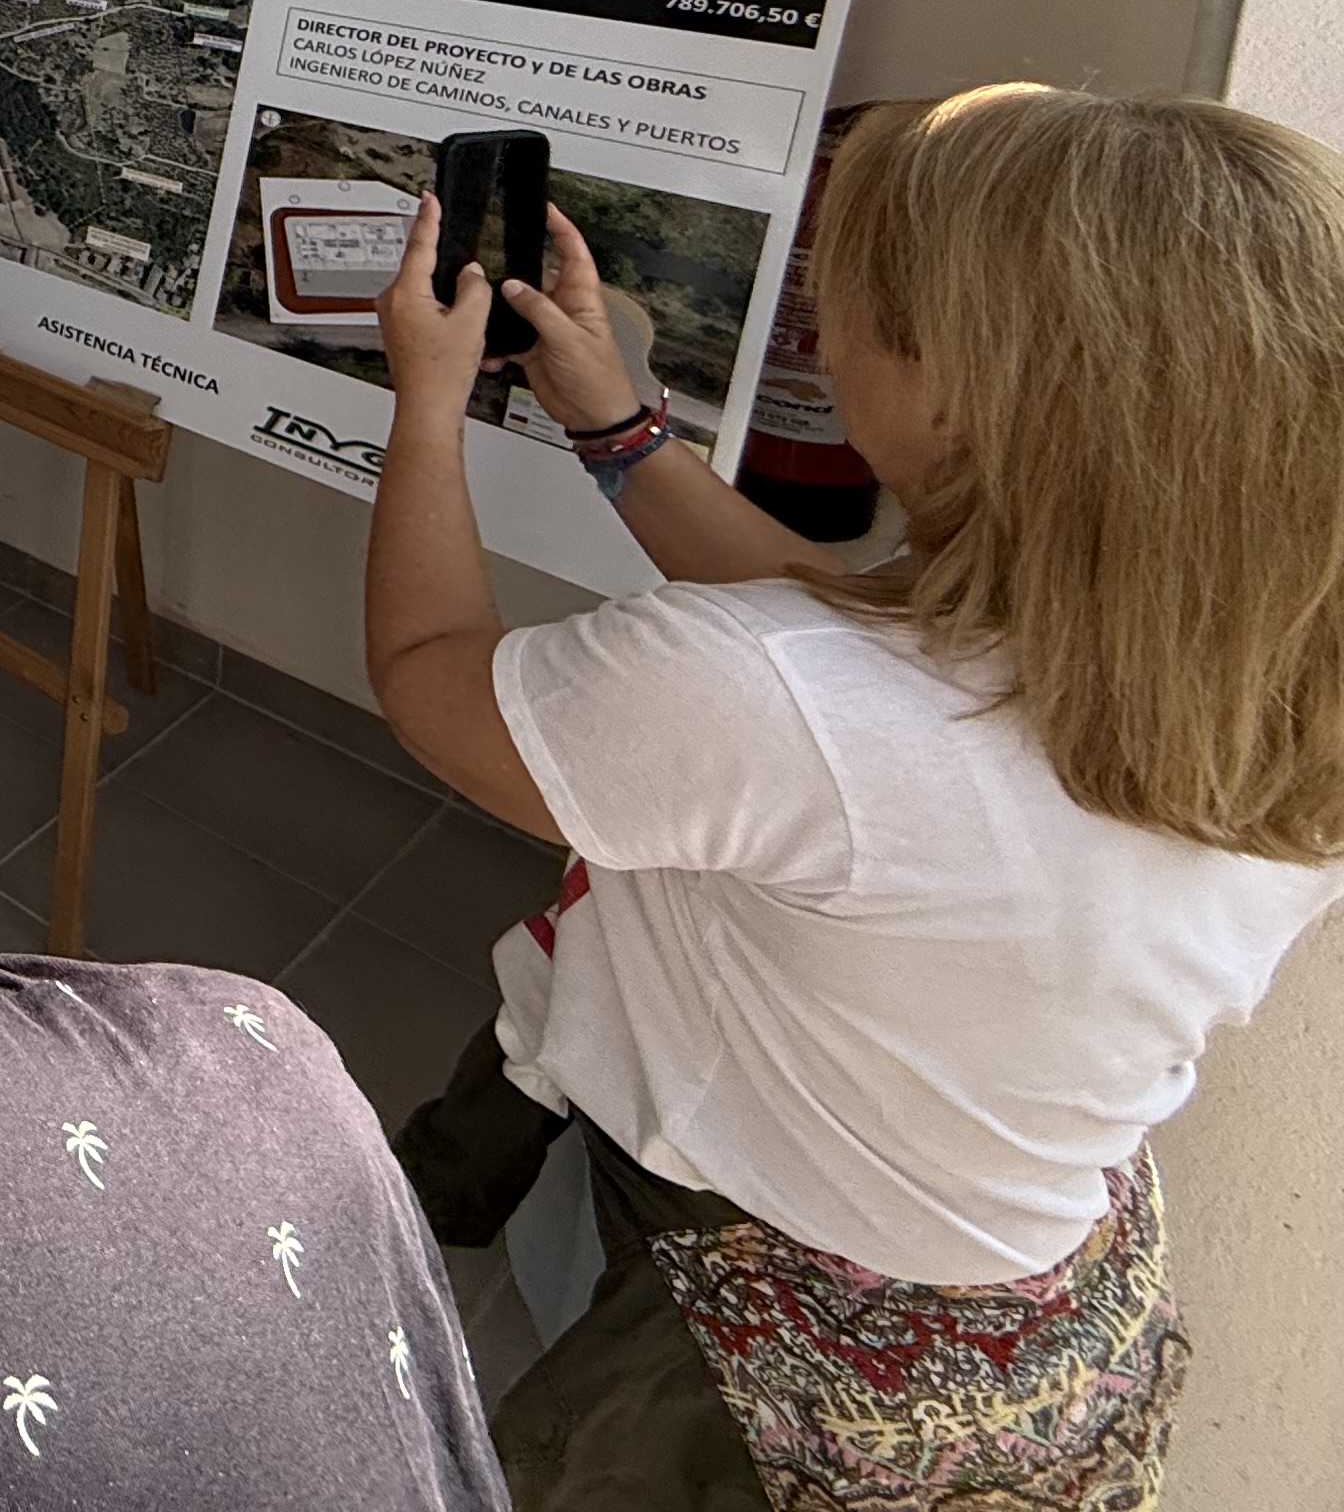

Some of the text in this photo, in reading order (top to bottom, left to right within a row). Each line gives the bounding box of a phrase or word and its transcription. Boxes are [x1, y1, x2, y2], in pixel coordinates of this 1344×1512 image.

[804, 12, 822, 29] €
[293, 37, 486, 85] CARLOS LÓPEZ NÚÑEZ
[296, 18, 708, 100] DIRECTOR DEL PROYECTO y DE LAS OBRAS
[289, 56, 741, 155] INGENIERO DE CAMINOS, CANALES Y PUERTOS
[37, 316, 220, 397] ASISTENCIA TÉCNICA
[250, 433, 376, 488] CONSULTOR
